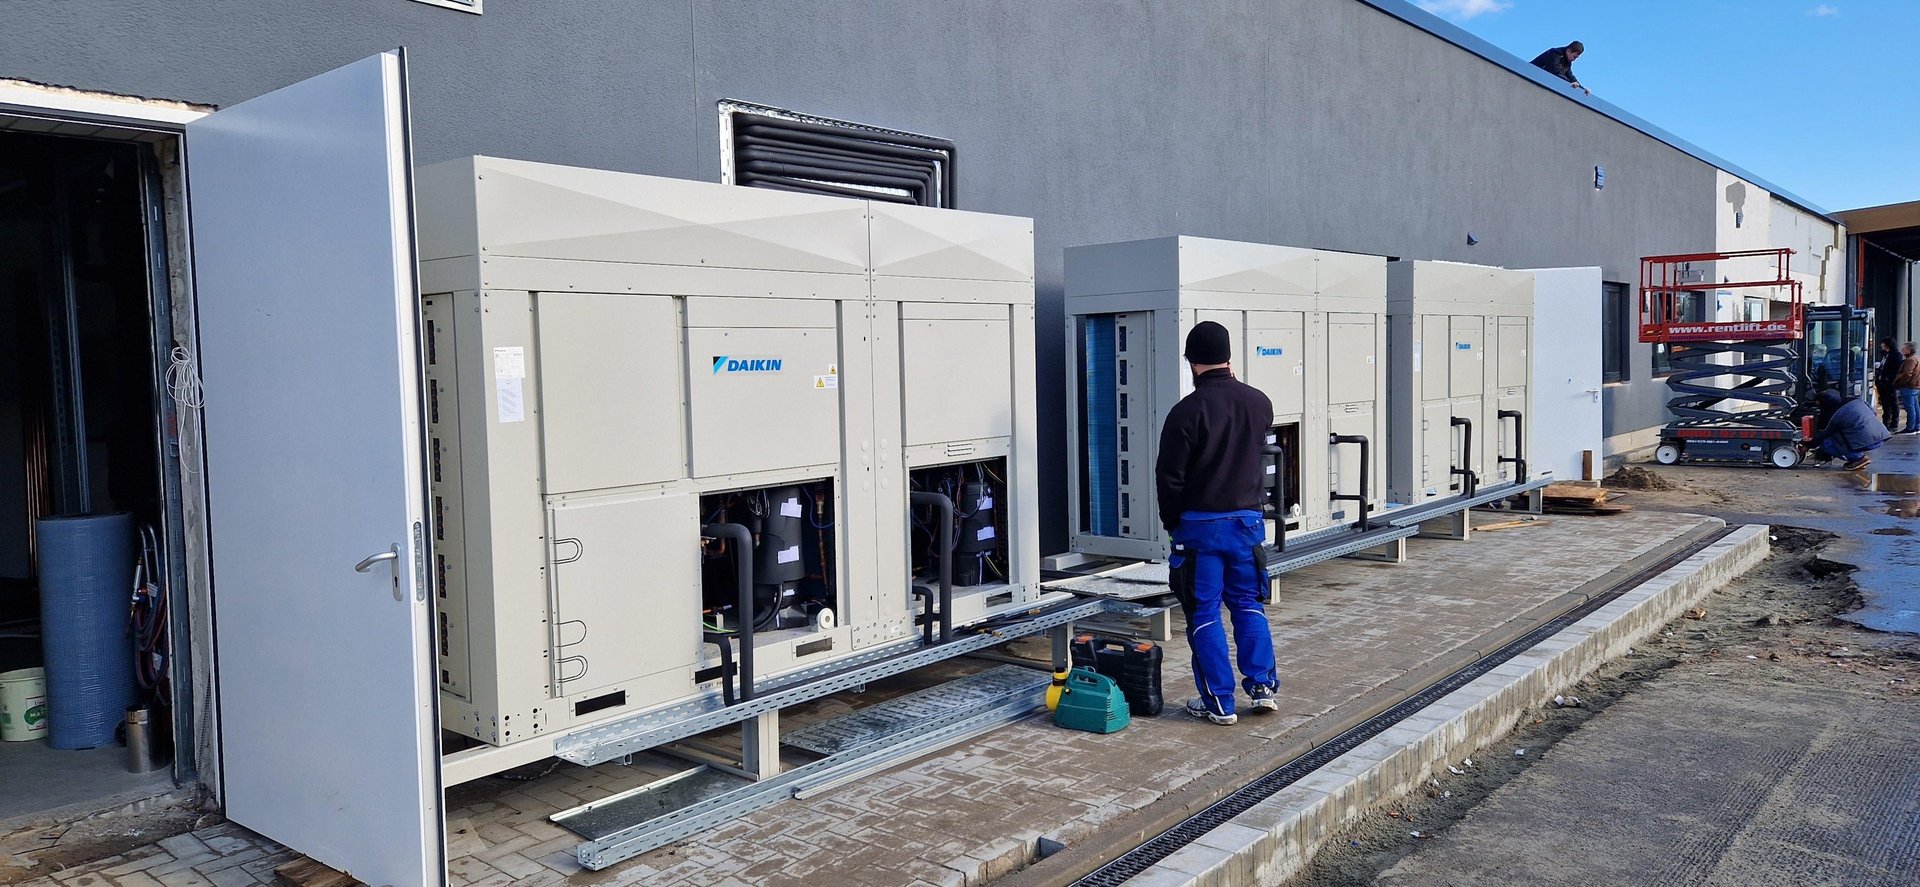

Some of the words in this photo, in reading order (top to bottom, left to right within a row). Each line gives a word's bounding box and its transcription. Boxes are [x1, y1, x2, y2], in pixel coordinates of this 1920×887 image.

[1669, 322, 1786, 334] www.rentlift.de
[1262, 348, 1282, 356] DAIKIN
[727, 359, 782, 372] DAIKIN
